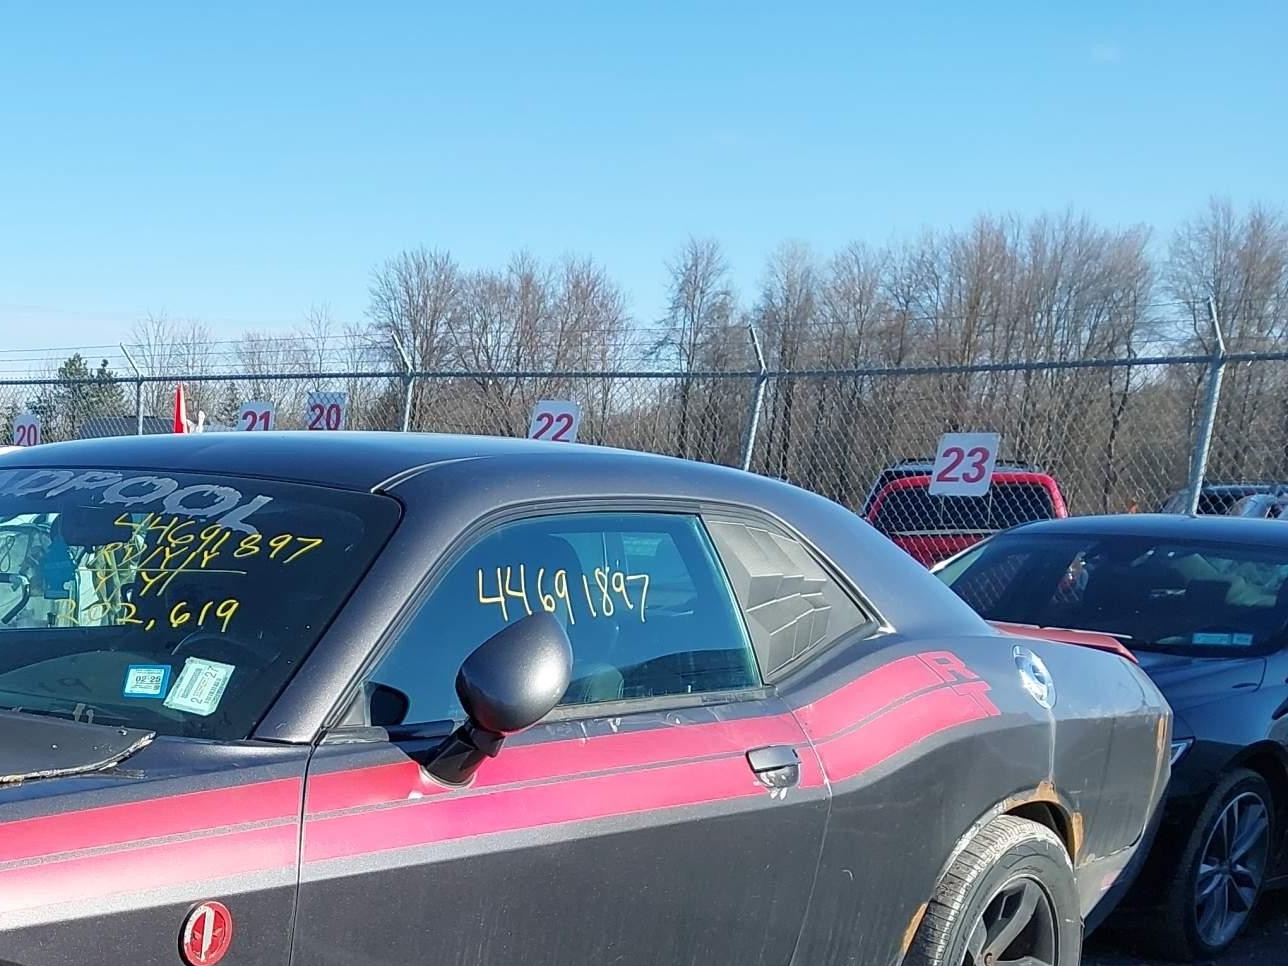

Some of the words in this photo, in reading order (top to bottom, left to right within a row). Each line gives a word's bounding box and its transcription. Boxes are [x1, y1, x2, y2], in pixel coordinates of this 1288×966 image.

[242, 411, 271, 431] 21
[309, 403, 341, 431] 20
[533, 412, 573, 442] 22
[16, 423, 38, 446] 20
[935, 447, 990, 483] 23
[114, 512, 323, 565] 44691897
[54, 598, 240, 634] 202,619
